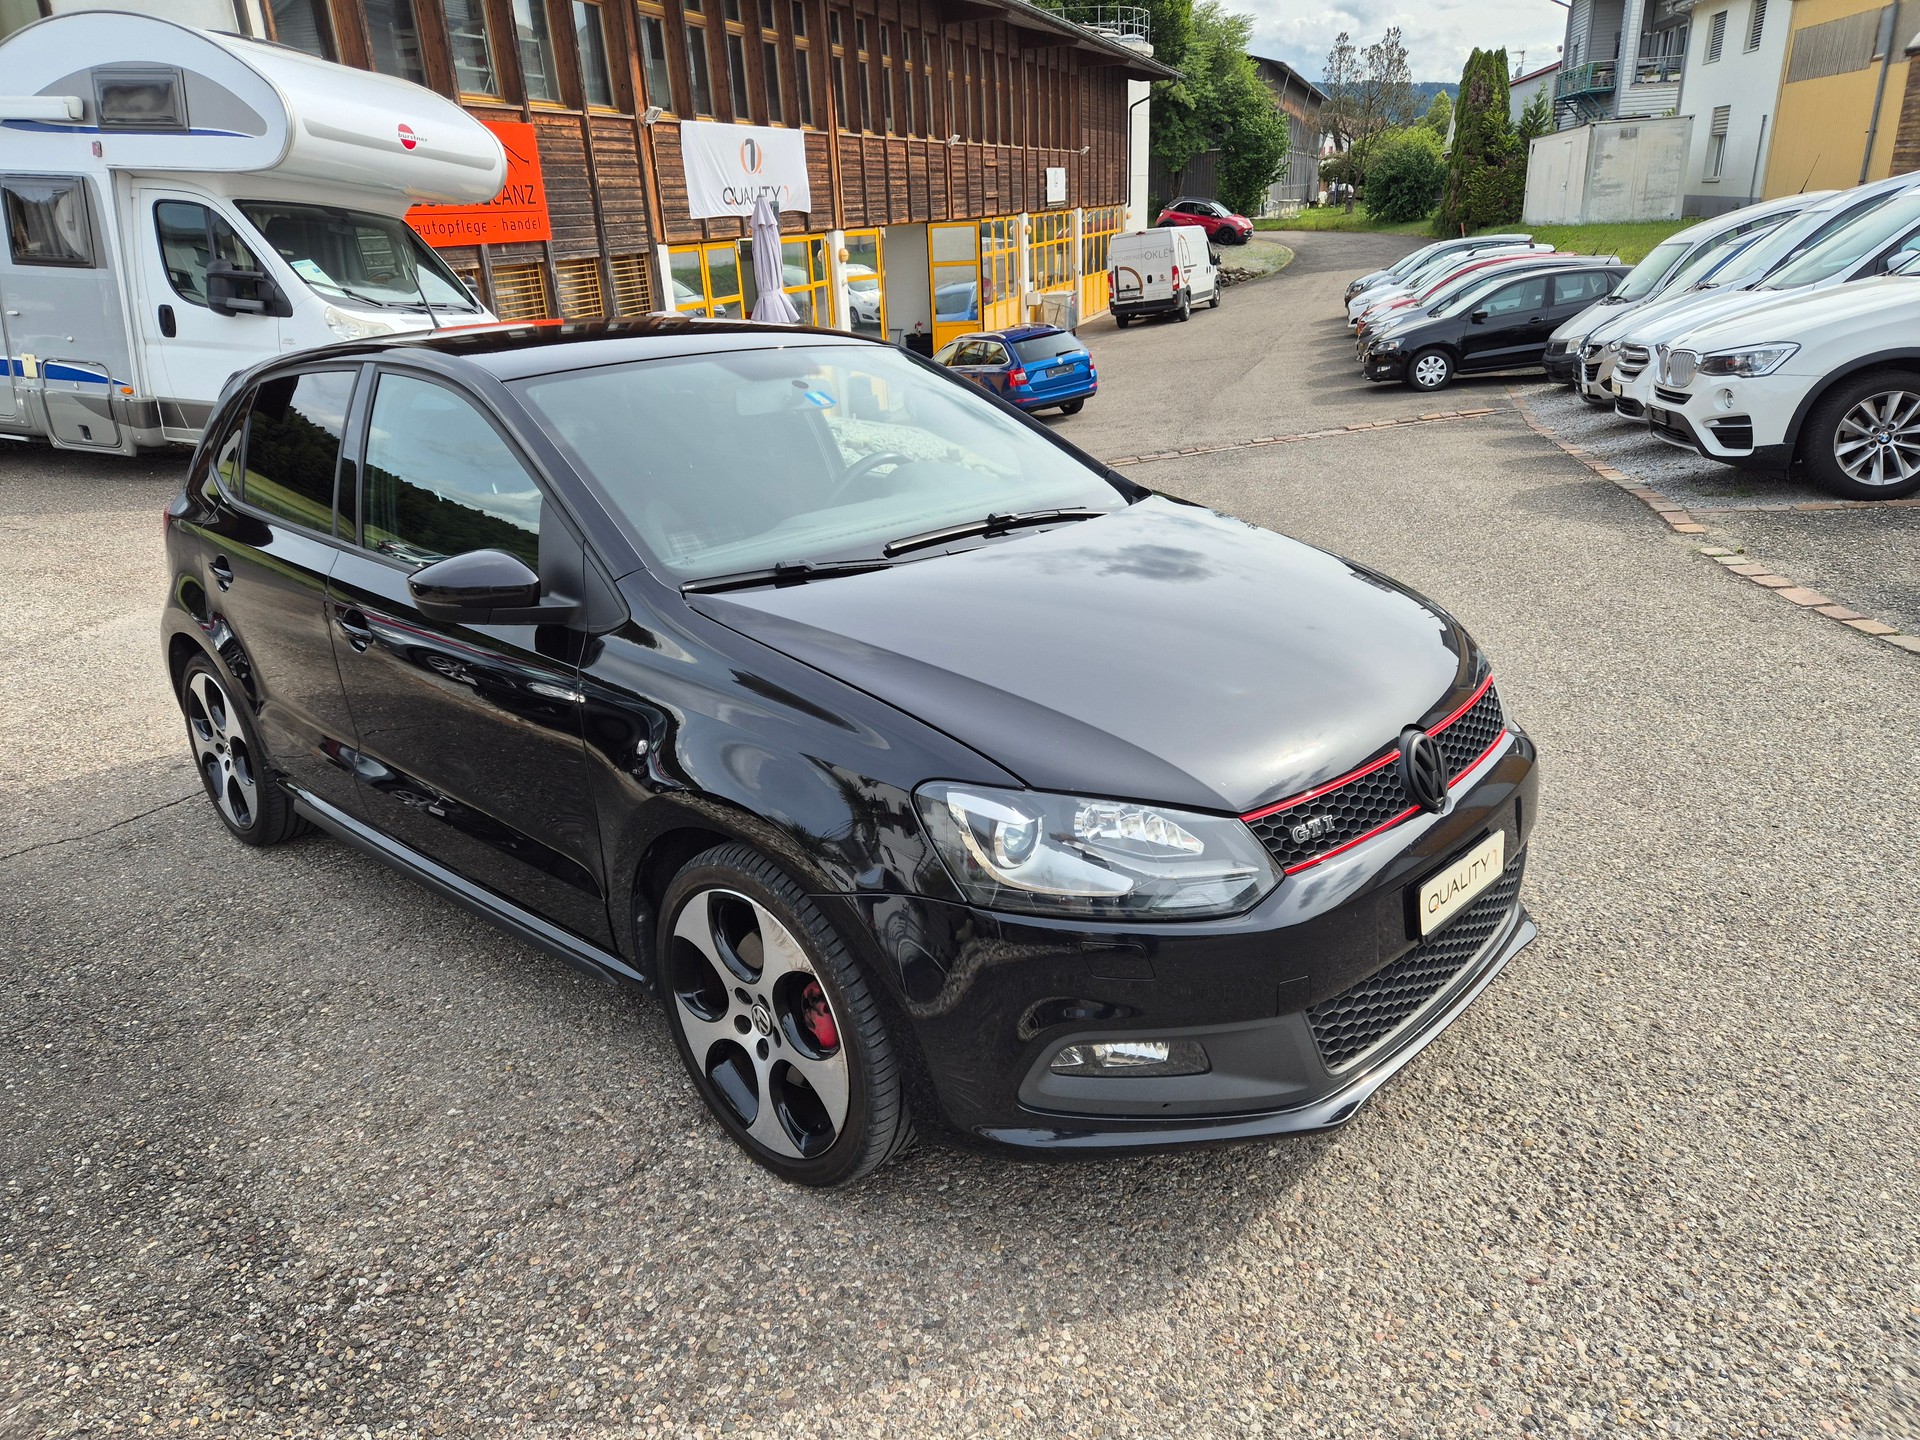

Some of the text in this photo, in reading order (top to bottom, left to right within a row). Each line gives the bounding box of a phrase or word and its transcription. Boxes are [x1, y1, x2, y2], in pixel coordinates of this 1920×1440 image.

[722, 186, 781, 205] QUALITY
[415, 220, 488, 237] autopflege
[501, 217, 541, 231] handel
[1292, 815, 1335, 844] GTI
[1428, 853, 1490, 914] QUALITY
